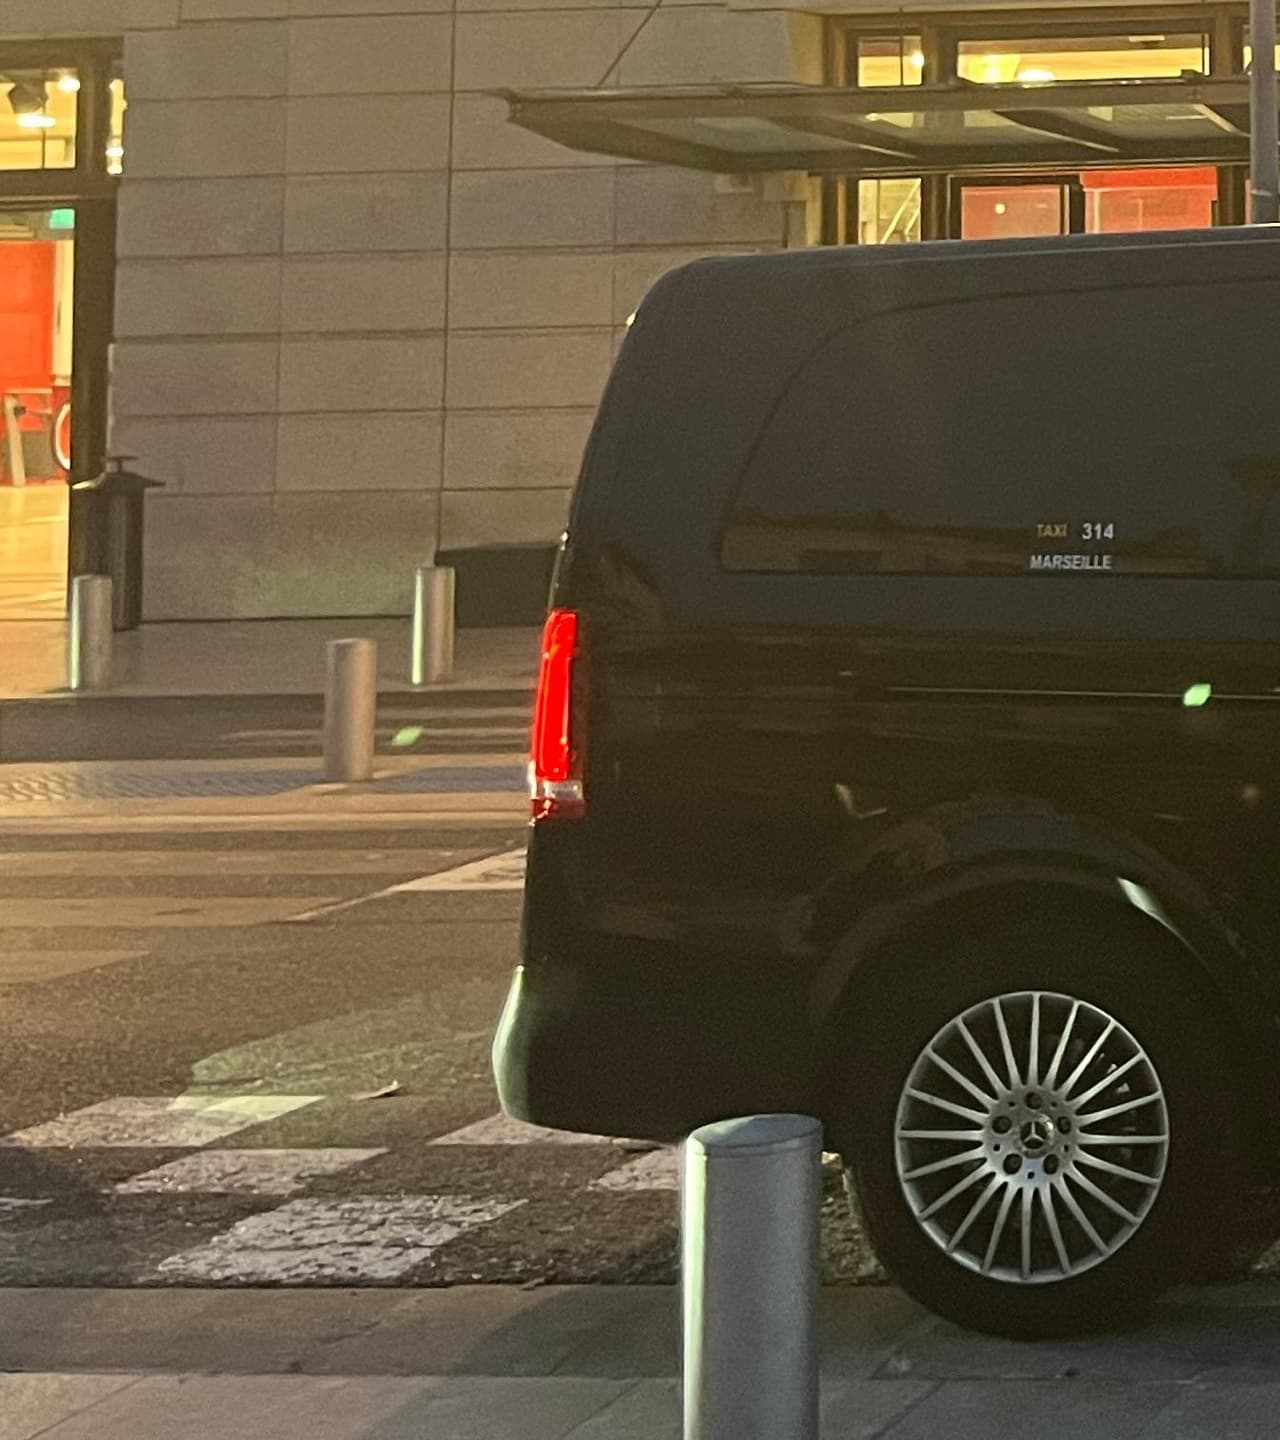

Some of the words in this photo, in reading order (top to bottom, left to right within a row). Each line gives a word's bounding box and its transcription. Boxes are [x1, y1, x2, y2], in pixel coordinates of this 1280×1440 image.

[1036, 523, 1067, 537] TAXI
[1082, 522, 1114, 540] 314
[1029, 554, 1113, 570] MARSEILLE
